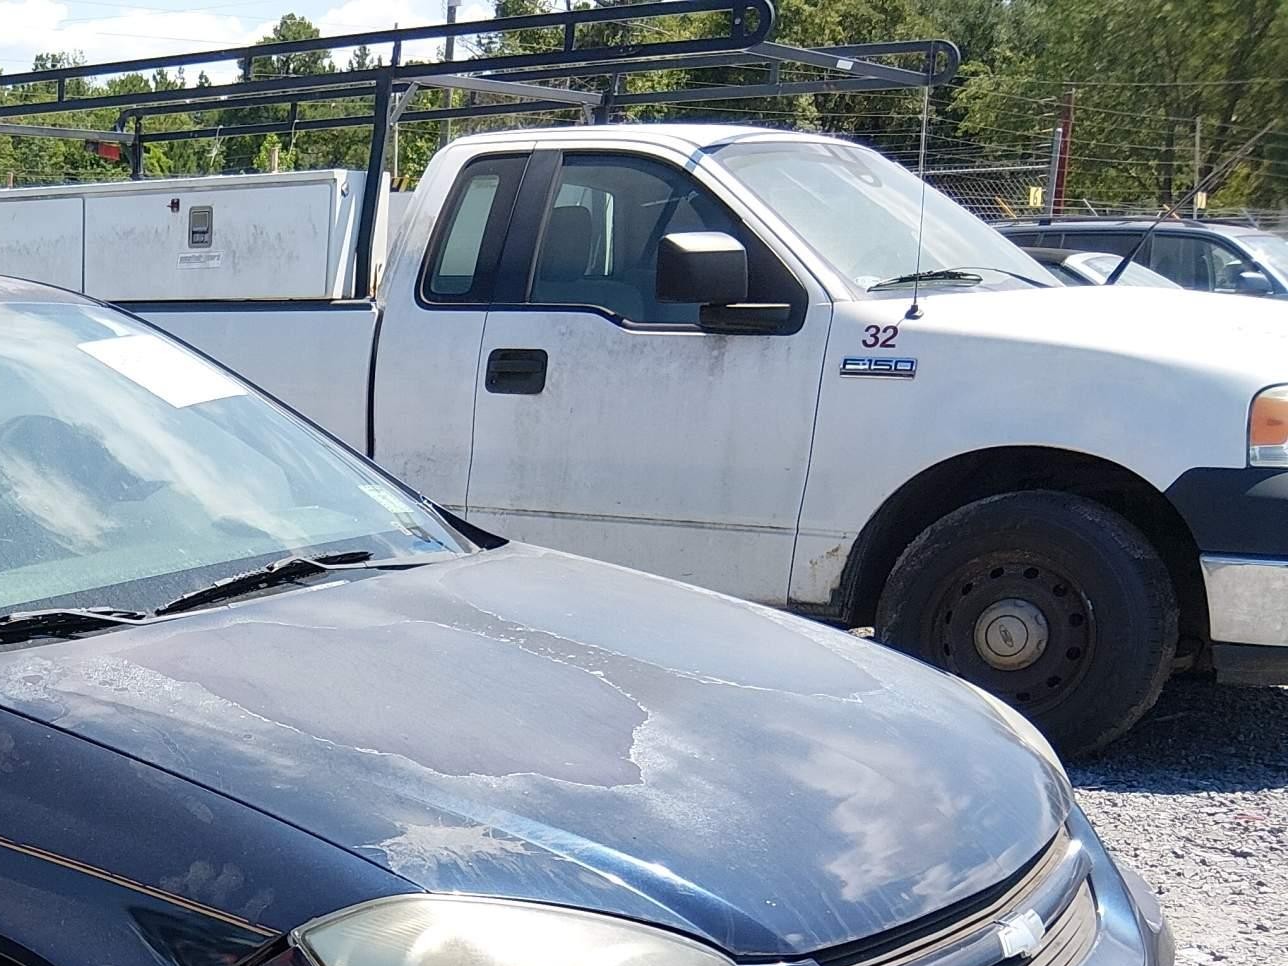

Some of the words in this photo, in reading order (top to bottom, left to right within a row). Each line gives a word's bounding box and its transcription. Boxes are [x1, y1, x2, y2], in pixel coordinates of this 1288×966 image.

[1033, 186, 1040, 206] 6
[861, 324, 899, 348] 32
[842, 358, 915, 372] F-150
